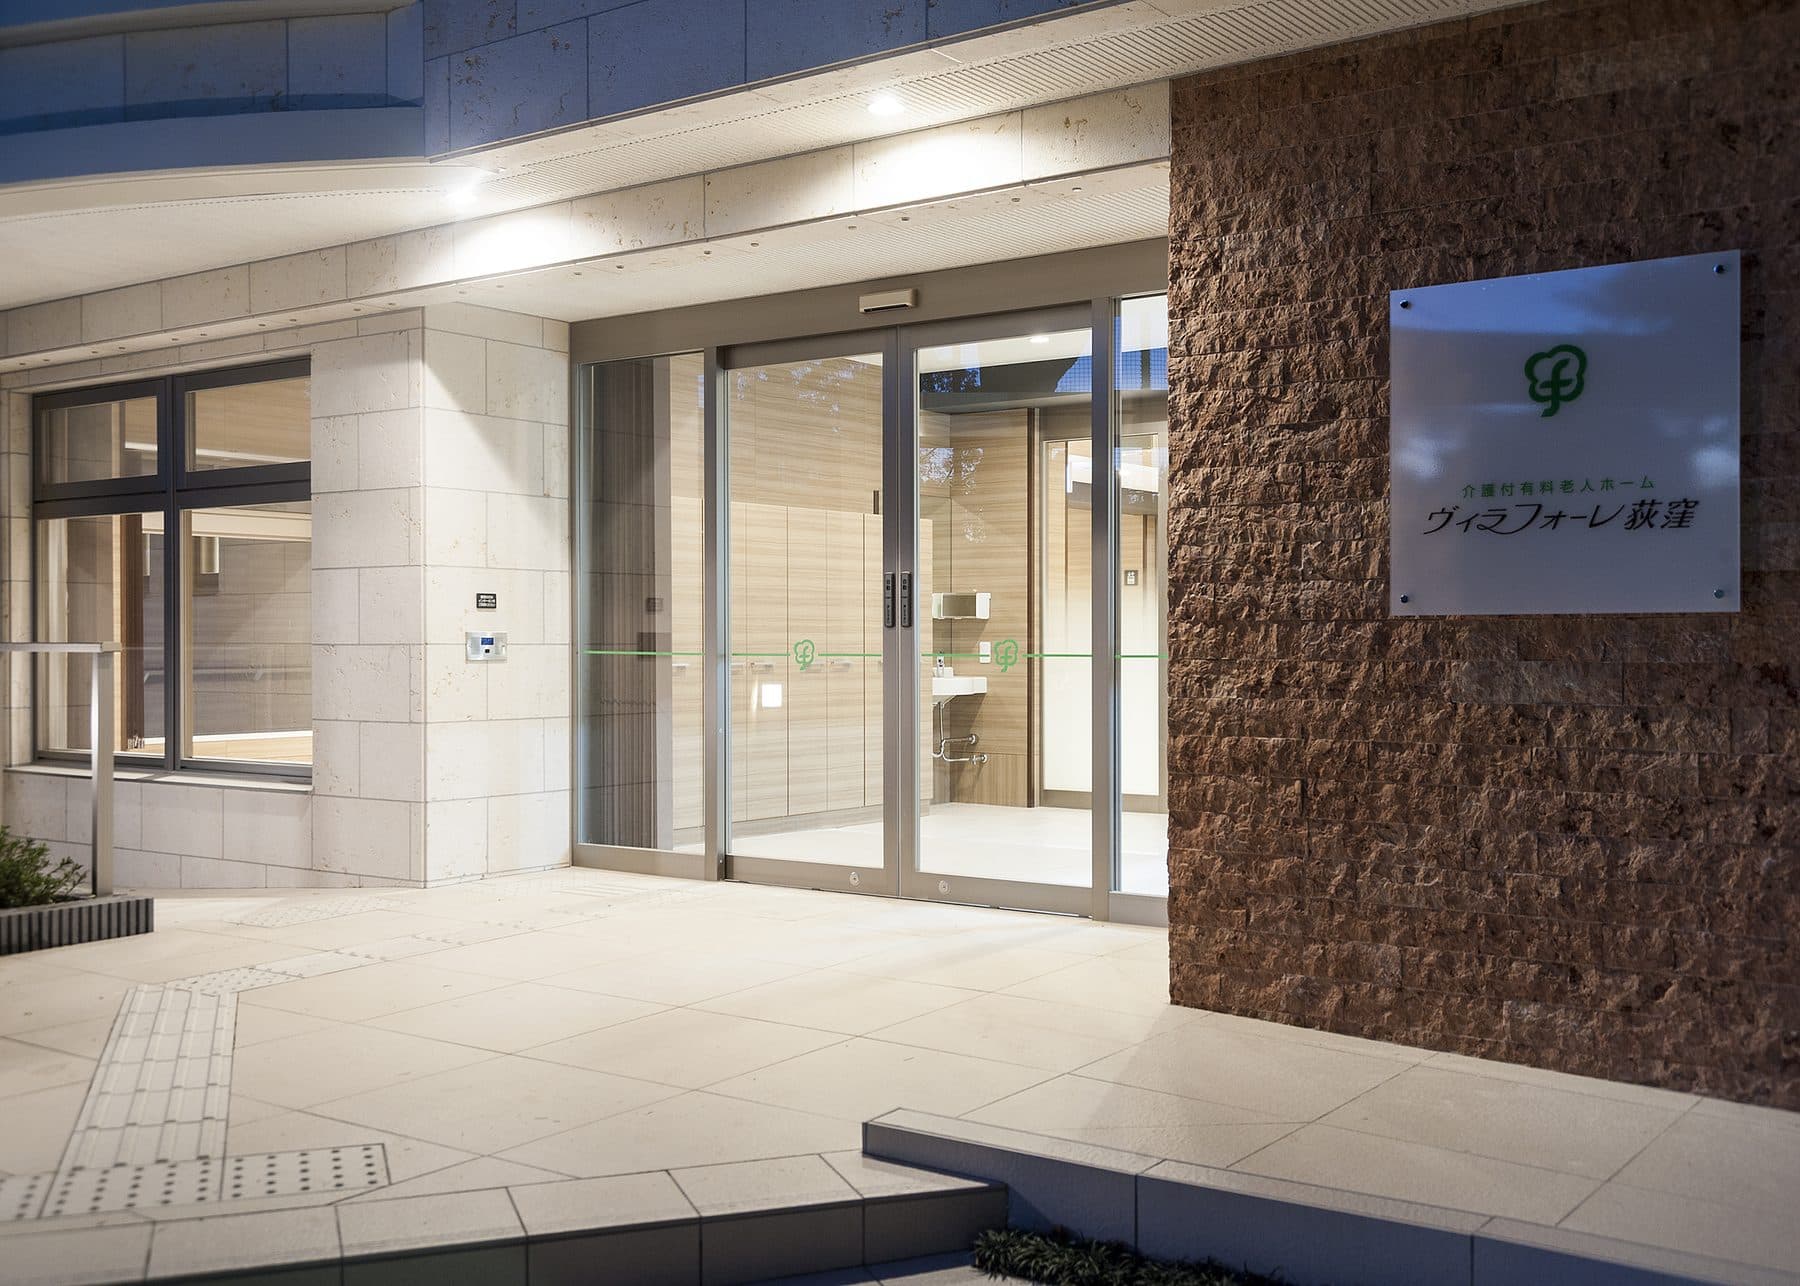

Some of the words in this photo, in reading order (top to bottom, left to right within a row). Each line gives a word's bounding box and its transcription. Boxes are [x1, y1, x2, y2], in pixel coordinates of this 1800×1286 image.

[1462, 476, 1655, 498] 介護付有料老人ホーム
[1423, 498, 1700, 535] ヴィラフォーレ荻窪
